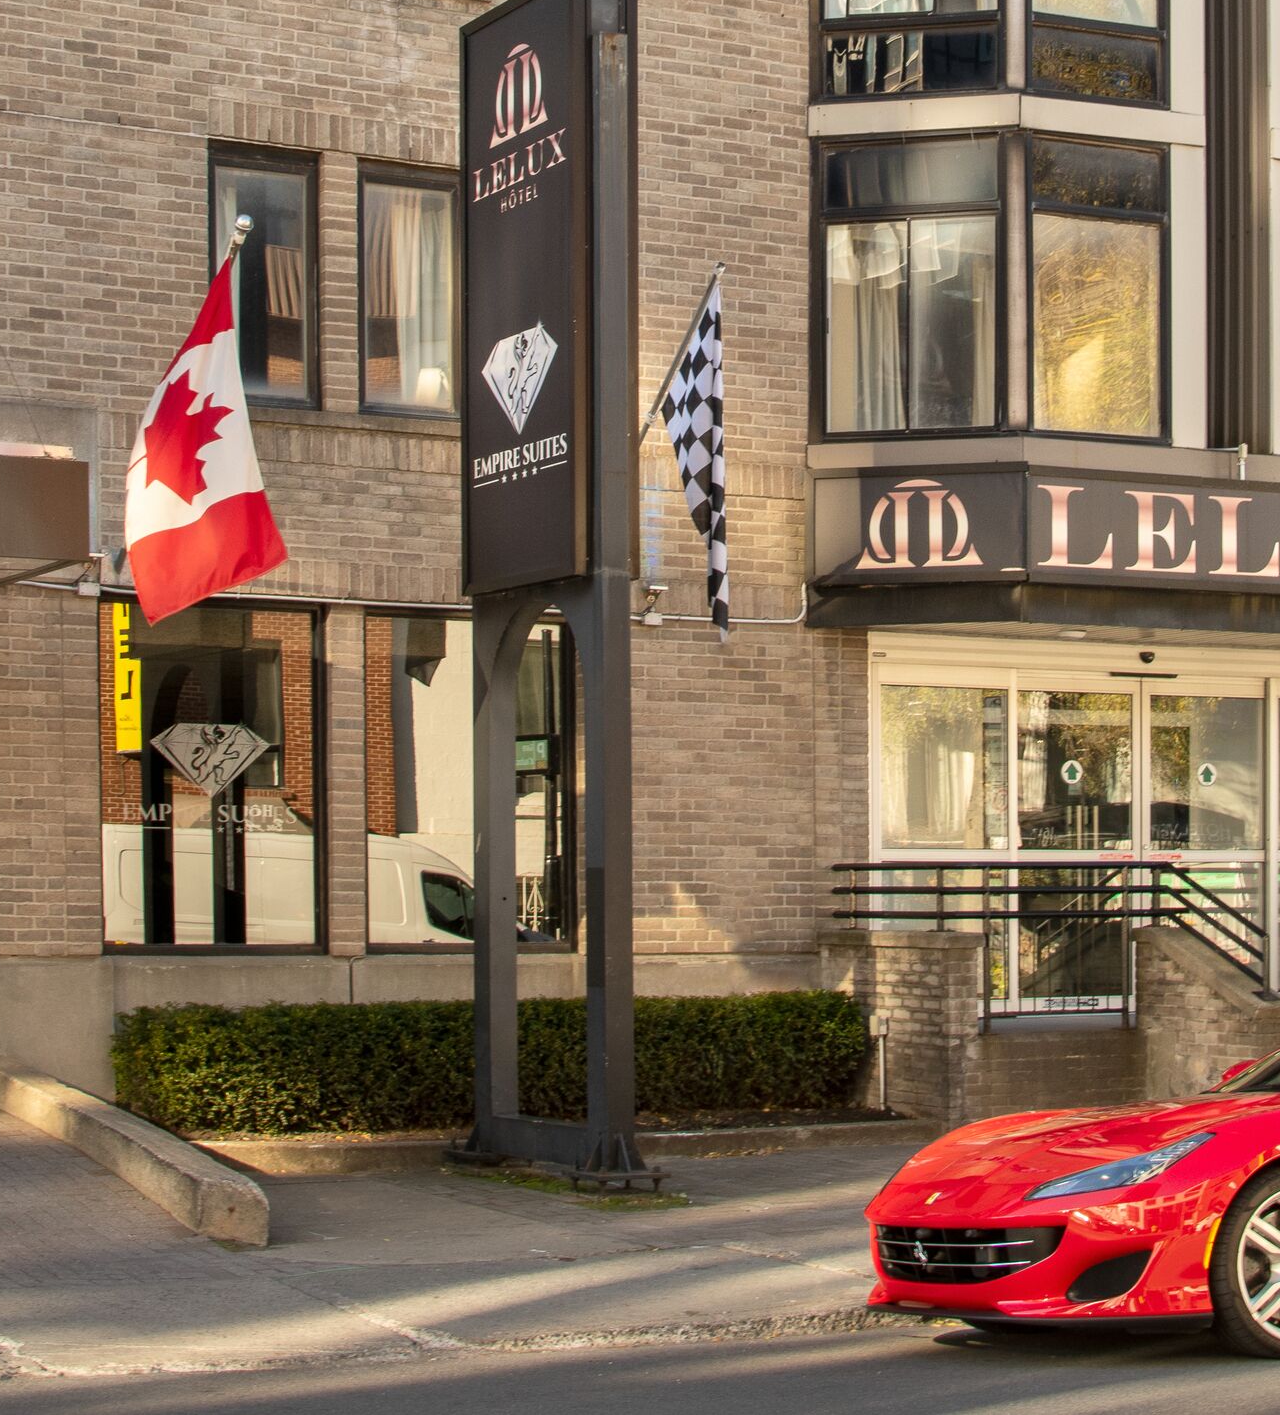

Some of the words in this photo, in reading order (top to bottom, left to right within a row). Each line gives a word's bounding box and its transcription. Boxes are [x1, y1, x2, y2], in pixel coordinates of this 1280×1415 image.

[473, 128, 567, 203] LELUX
[500, 183, 538, 214] HÔTEL
[473, 447, 521, 479] EMPIRE
[522, 432, 568, 465] SUITES
